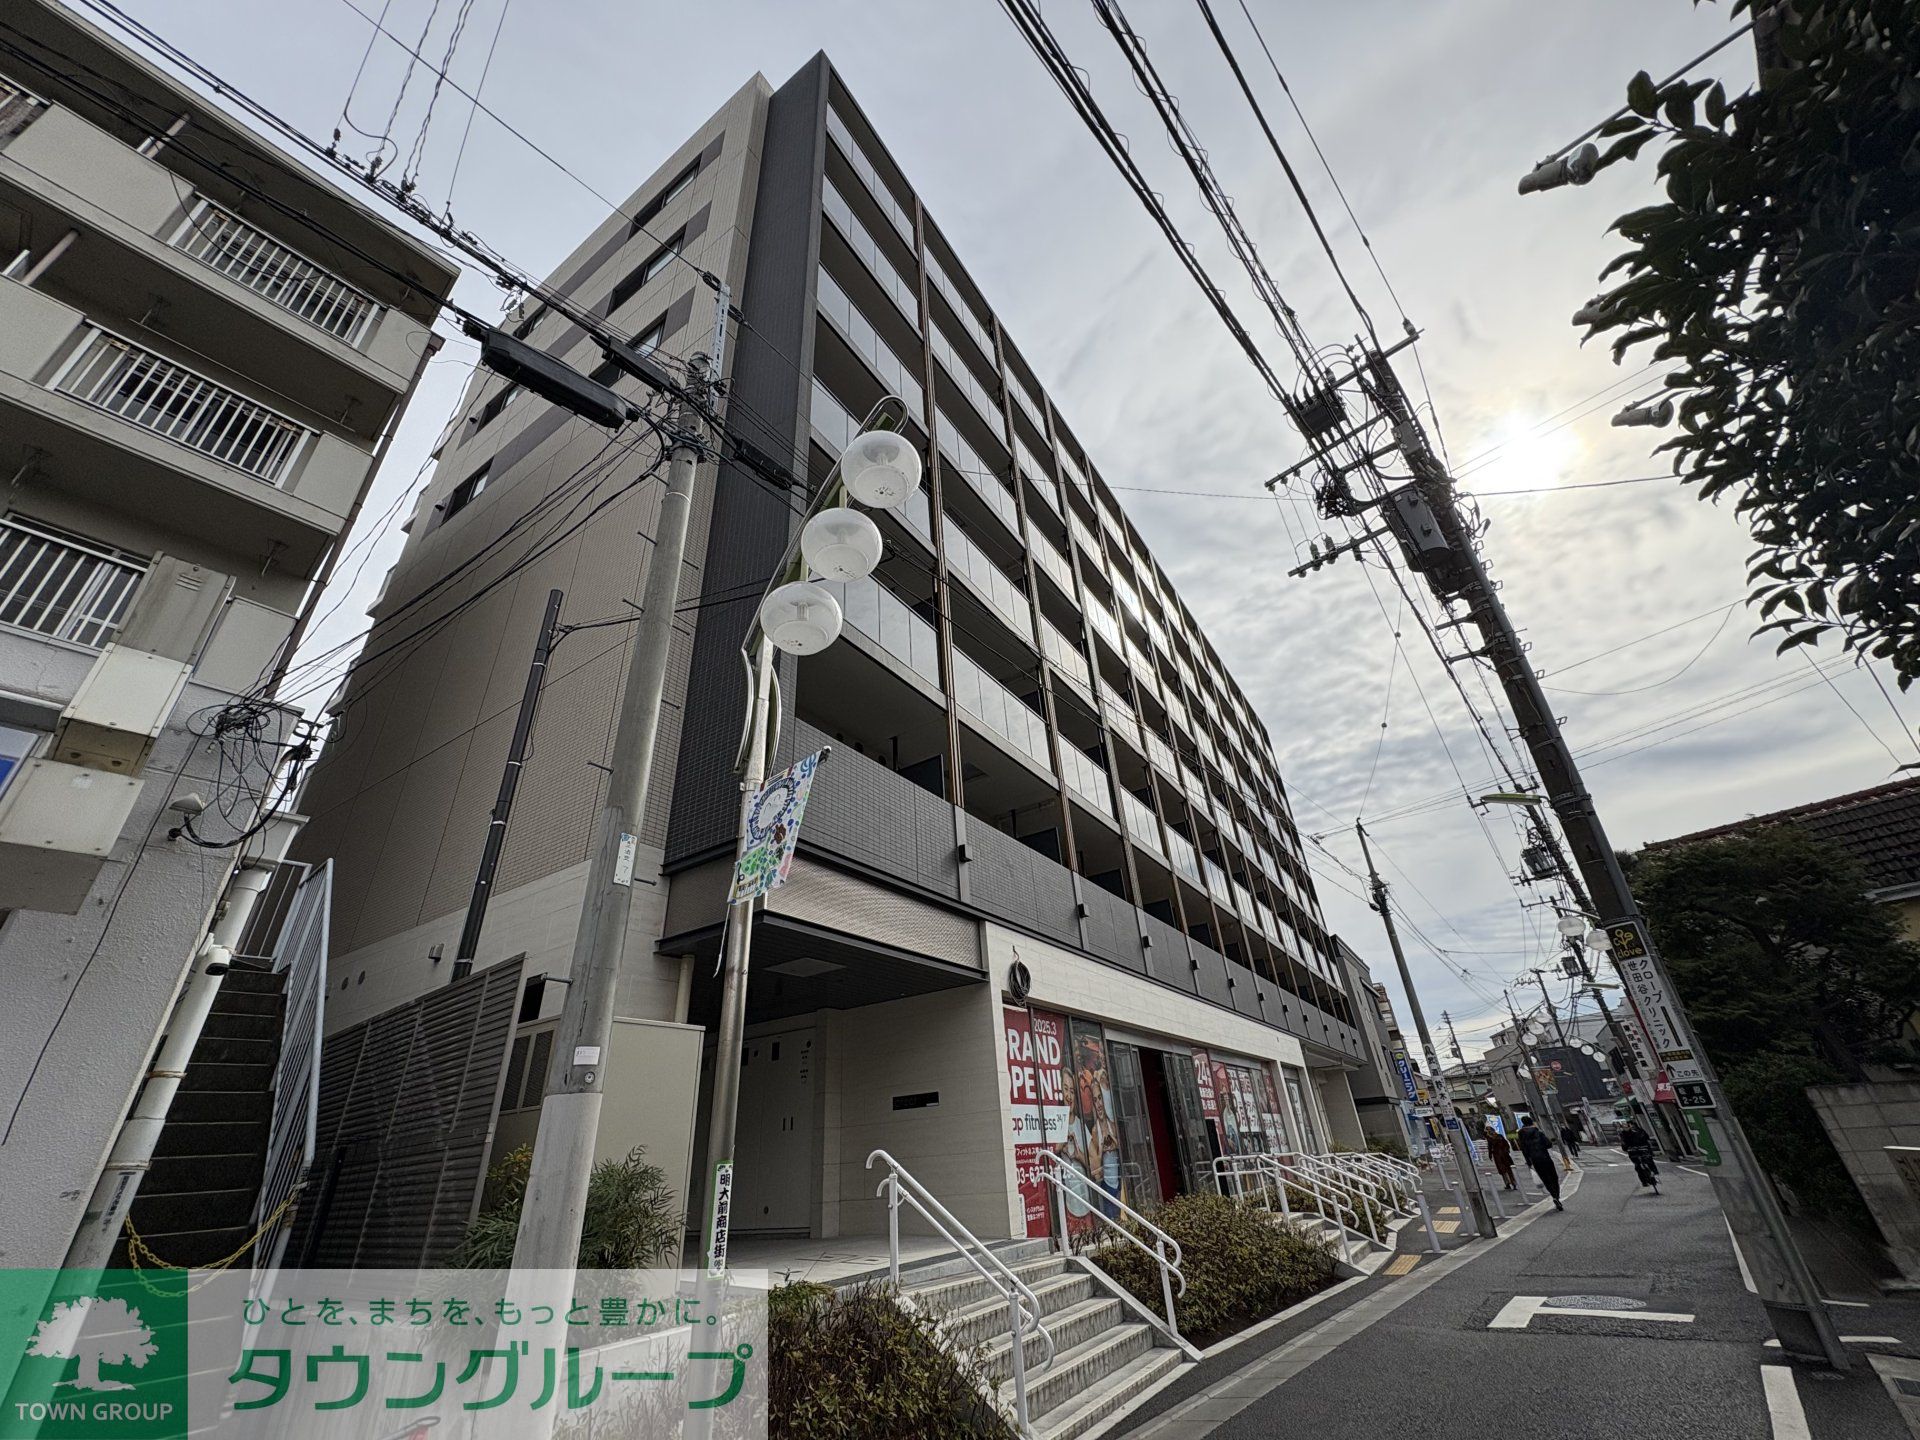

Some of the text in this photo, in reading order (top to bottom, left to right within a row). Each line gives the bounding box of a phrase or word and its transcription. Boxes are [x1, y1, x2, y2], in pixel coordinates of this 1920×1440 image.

[1617, 947, 1643, 958] clove
[1639, 959, 1663, 1003] クローブ
[1627, 961, 1670, 1049] 世田谷クリニック
[1034, 1018, 1057, 1035] 2025.3
[1005, 1028, 1061, 1065] RAND
[1009, 1065, 1063, 1100] PEN!!
[1398, 1060, 1416, 1099] クリーニング
[1677, 1070, 1699, 1078] この先
[1682, 1095, 1706, 1104] 2-25
[714, 1173, 731, 1259] 明大前商店街
